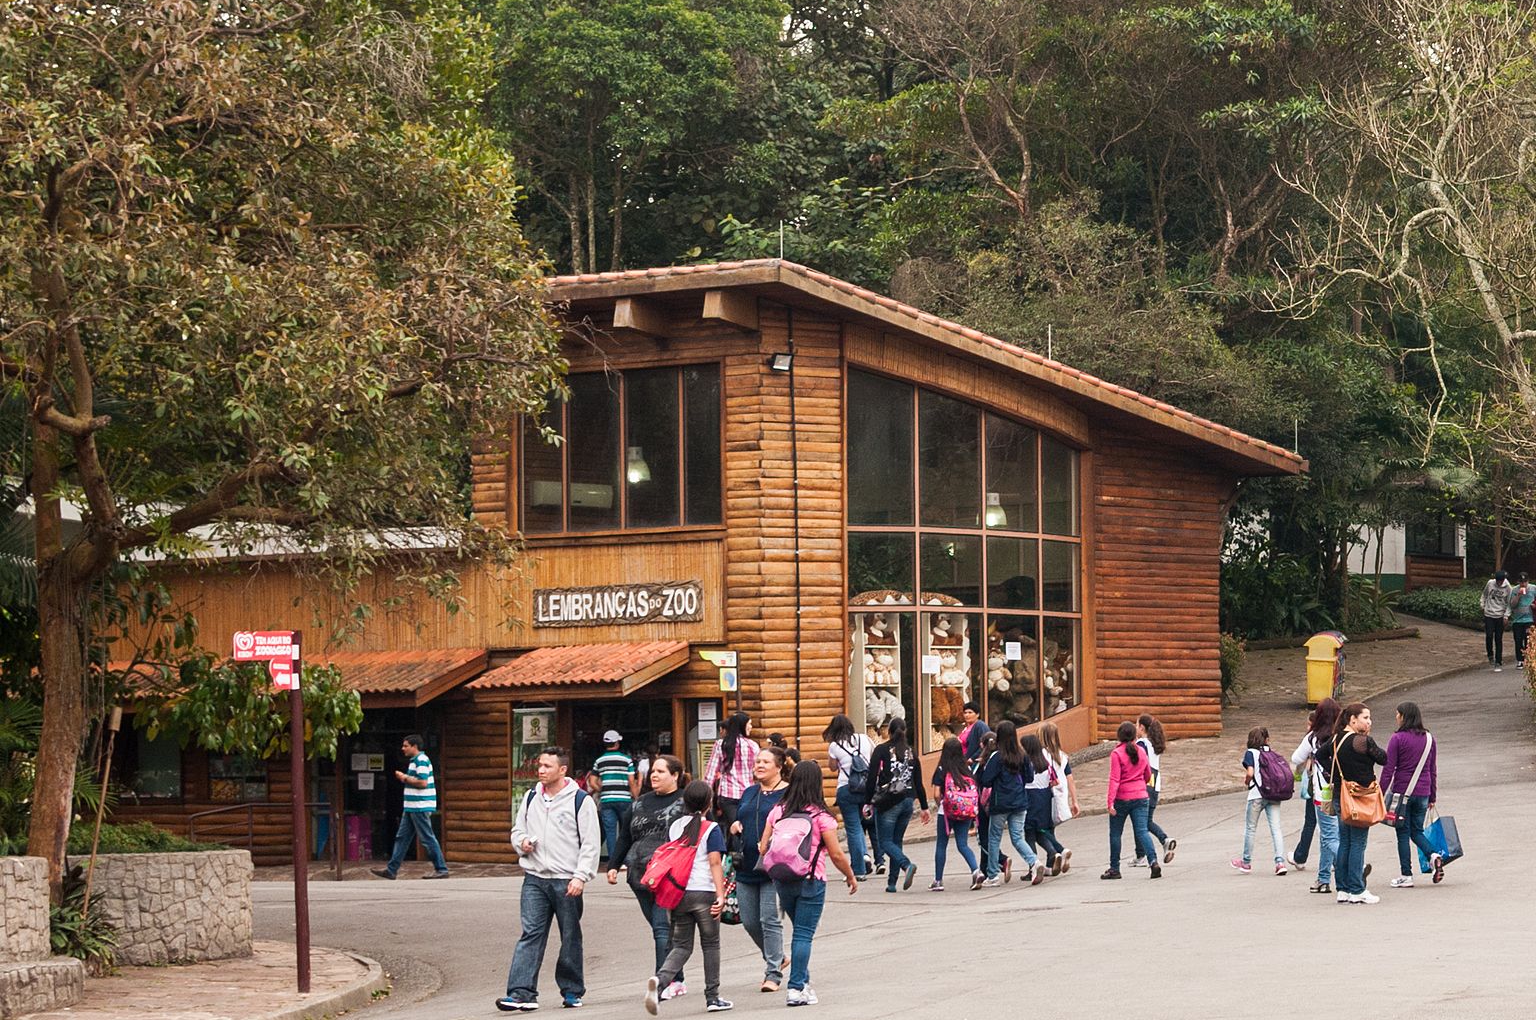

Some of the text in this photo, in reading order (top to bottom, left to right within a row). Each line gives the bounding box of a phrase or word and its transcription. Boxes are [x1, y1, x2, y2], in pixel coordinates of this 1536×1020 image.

[538, 588, 697, 622] LEMBRANÇAS DO ZOO
